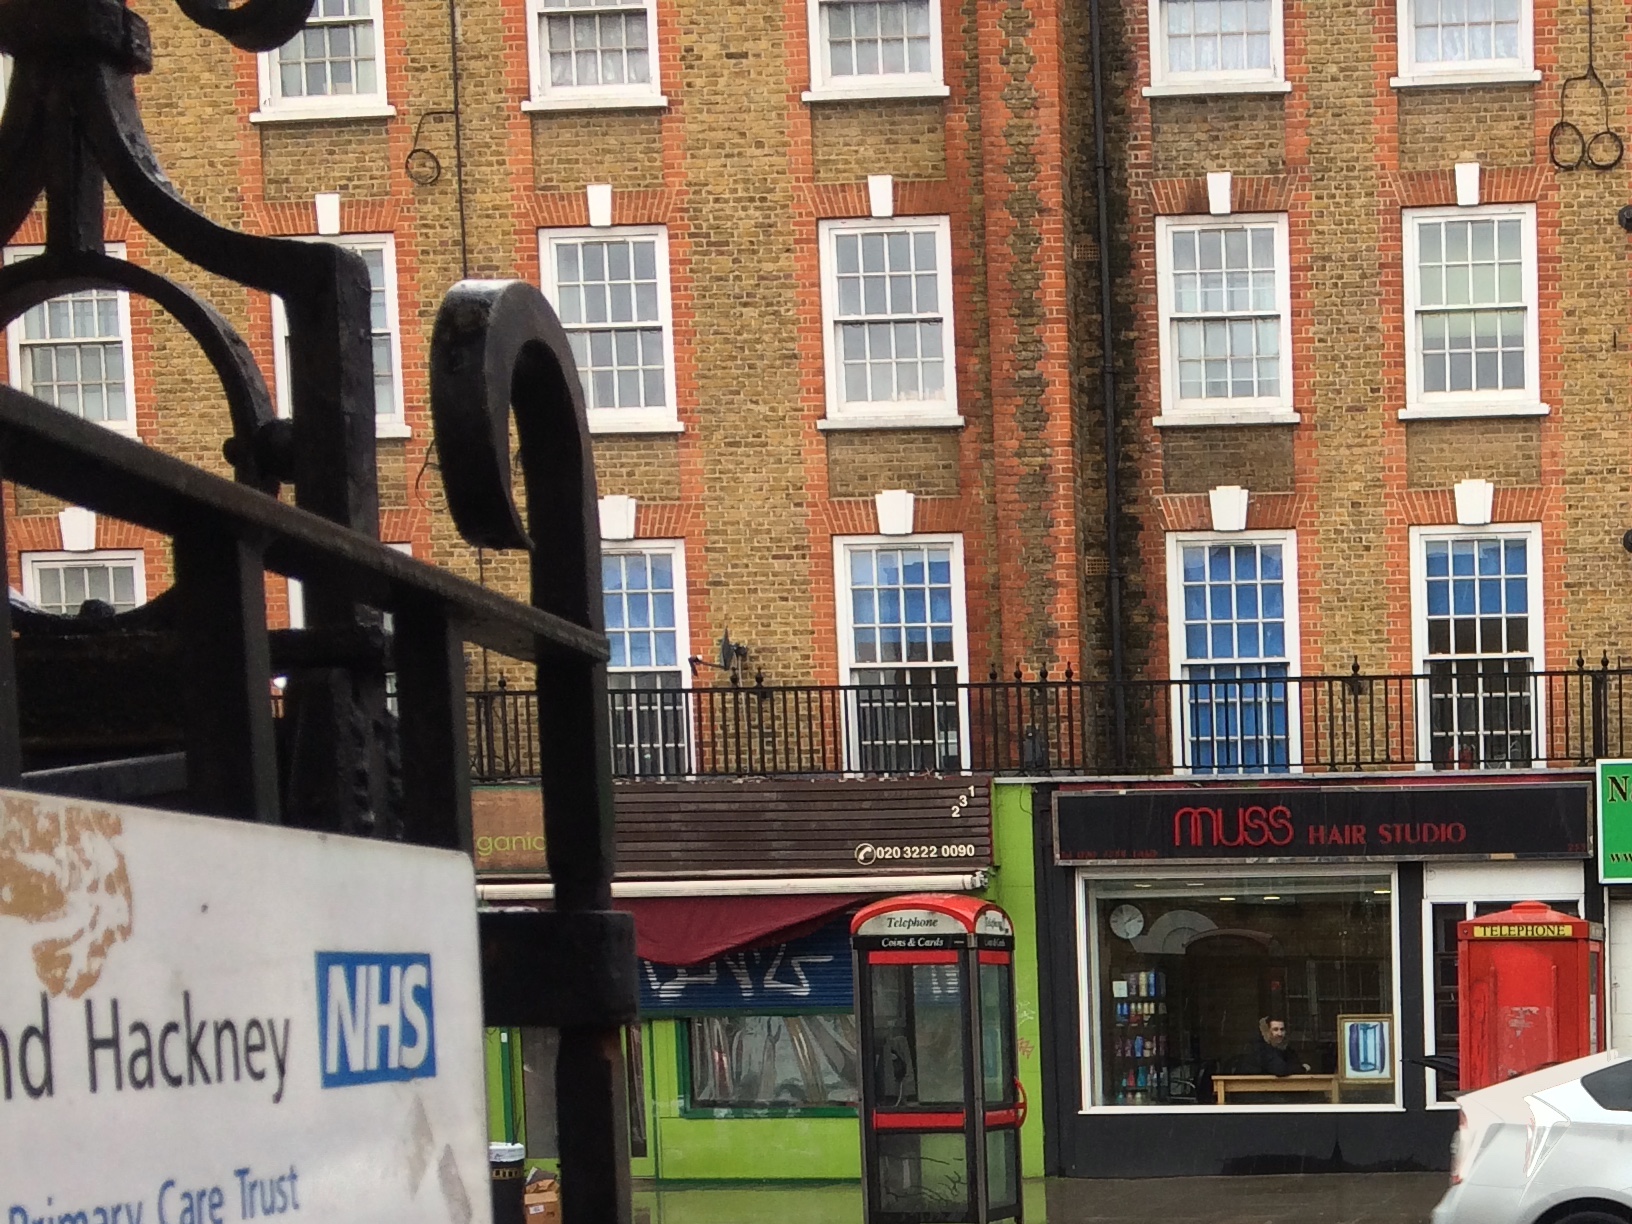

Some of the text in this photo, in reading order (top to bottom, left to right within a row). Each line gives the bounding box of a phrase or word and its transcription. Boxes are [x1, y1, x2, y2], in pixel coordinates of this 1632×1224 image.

[1308, 824, 1367, 845] HAIR
[1378, 822, 1467, 844] STUDIO
[876, 844, 975, 859] 020 3222 0090
[887, 917, 939, 930] Telephone
[1481, 924, 1567, 937] TELEPHONE
[881, 937, 944, 947] Coins & Cards
[325, 963, 431, 1075] NHS
[83, 989, 291, 1104] Hackney
[232, 1164, 300, 1221] Trust
